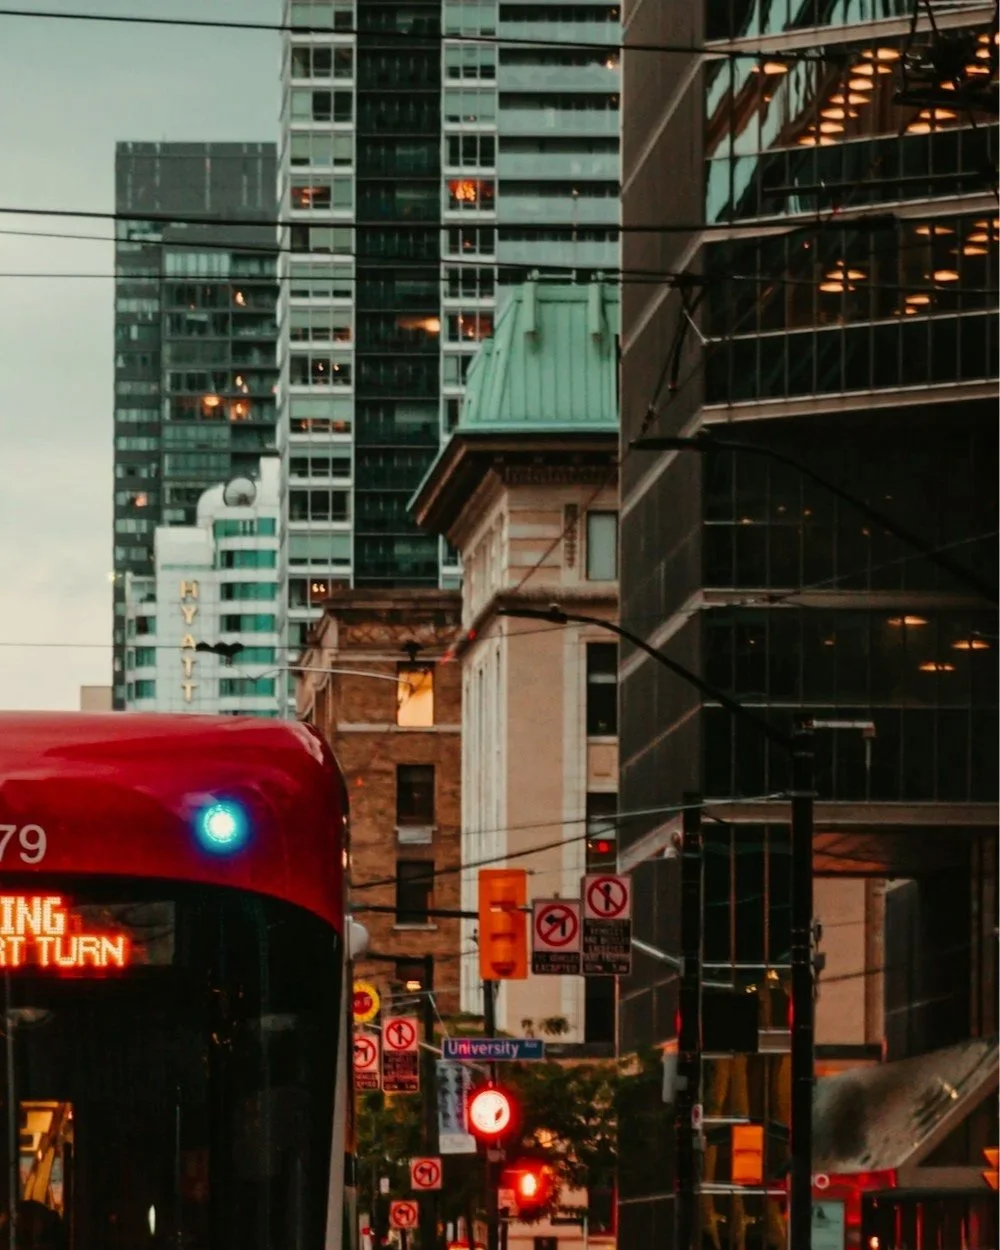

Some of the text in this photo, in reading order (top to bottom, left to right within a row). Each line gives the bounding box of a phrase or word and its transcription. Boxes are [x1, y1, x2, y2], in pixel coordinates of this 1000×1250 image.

[179, 580, 199, 702] HYATT
[36, 936, 125, 967] TURN
[447, 1041, 519, 1058] University
